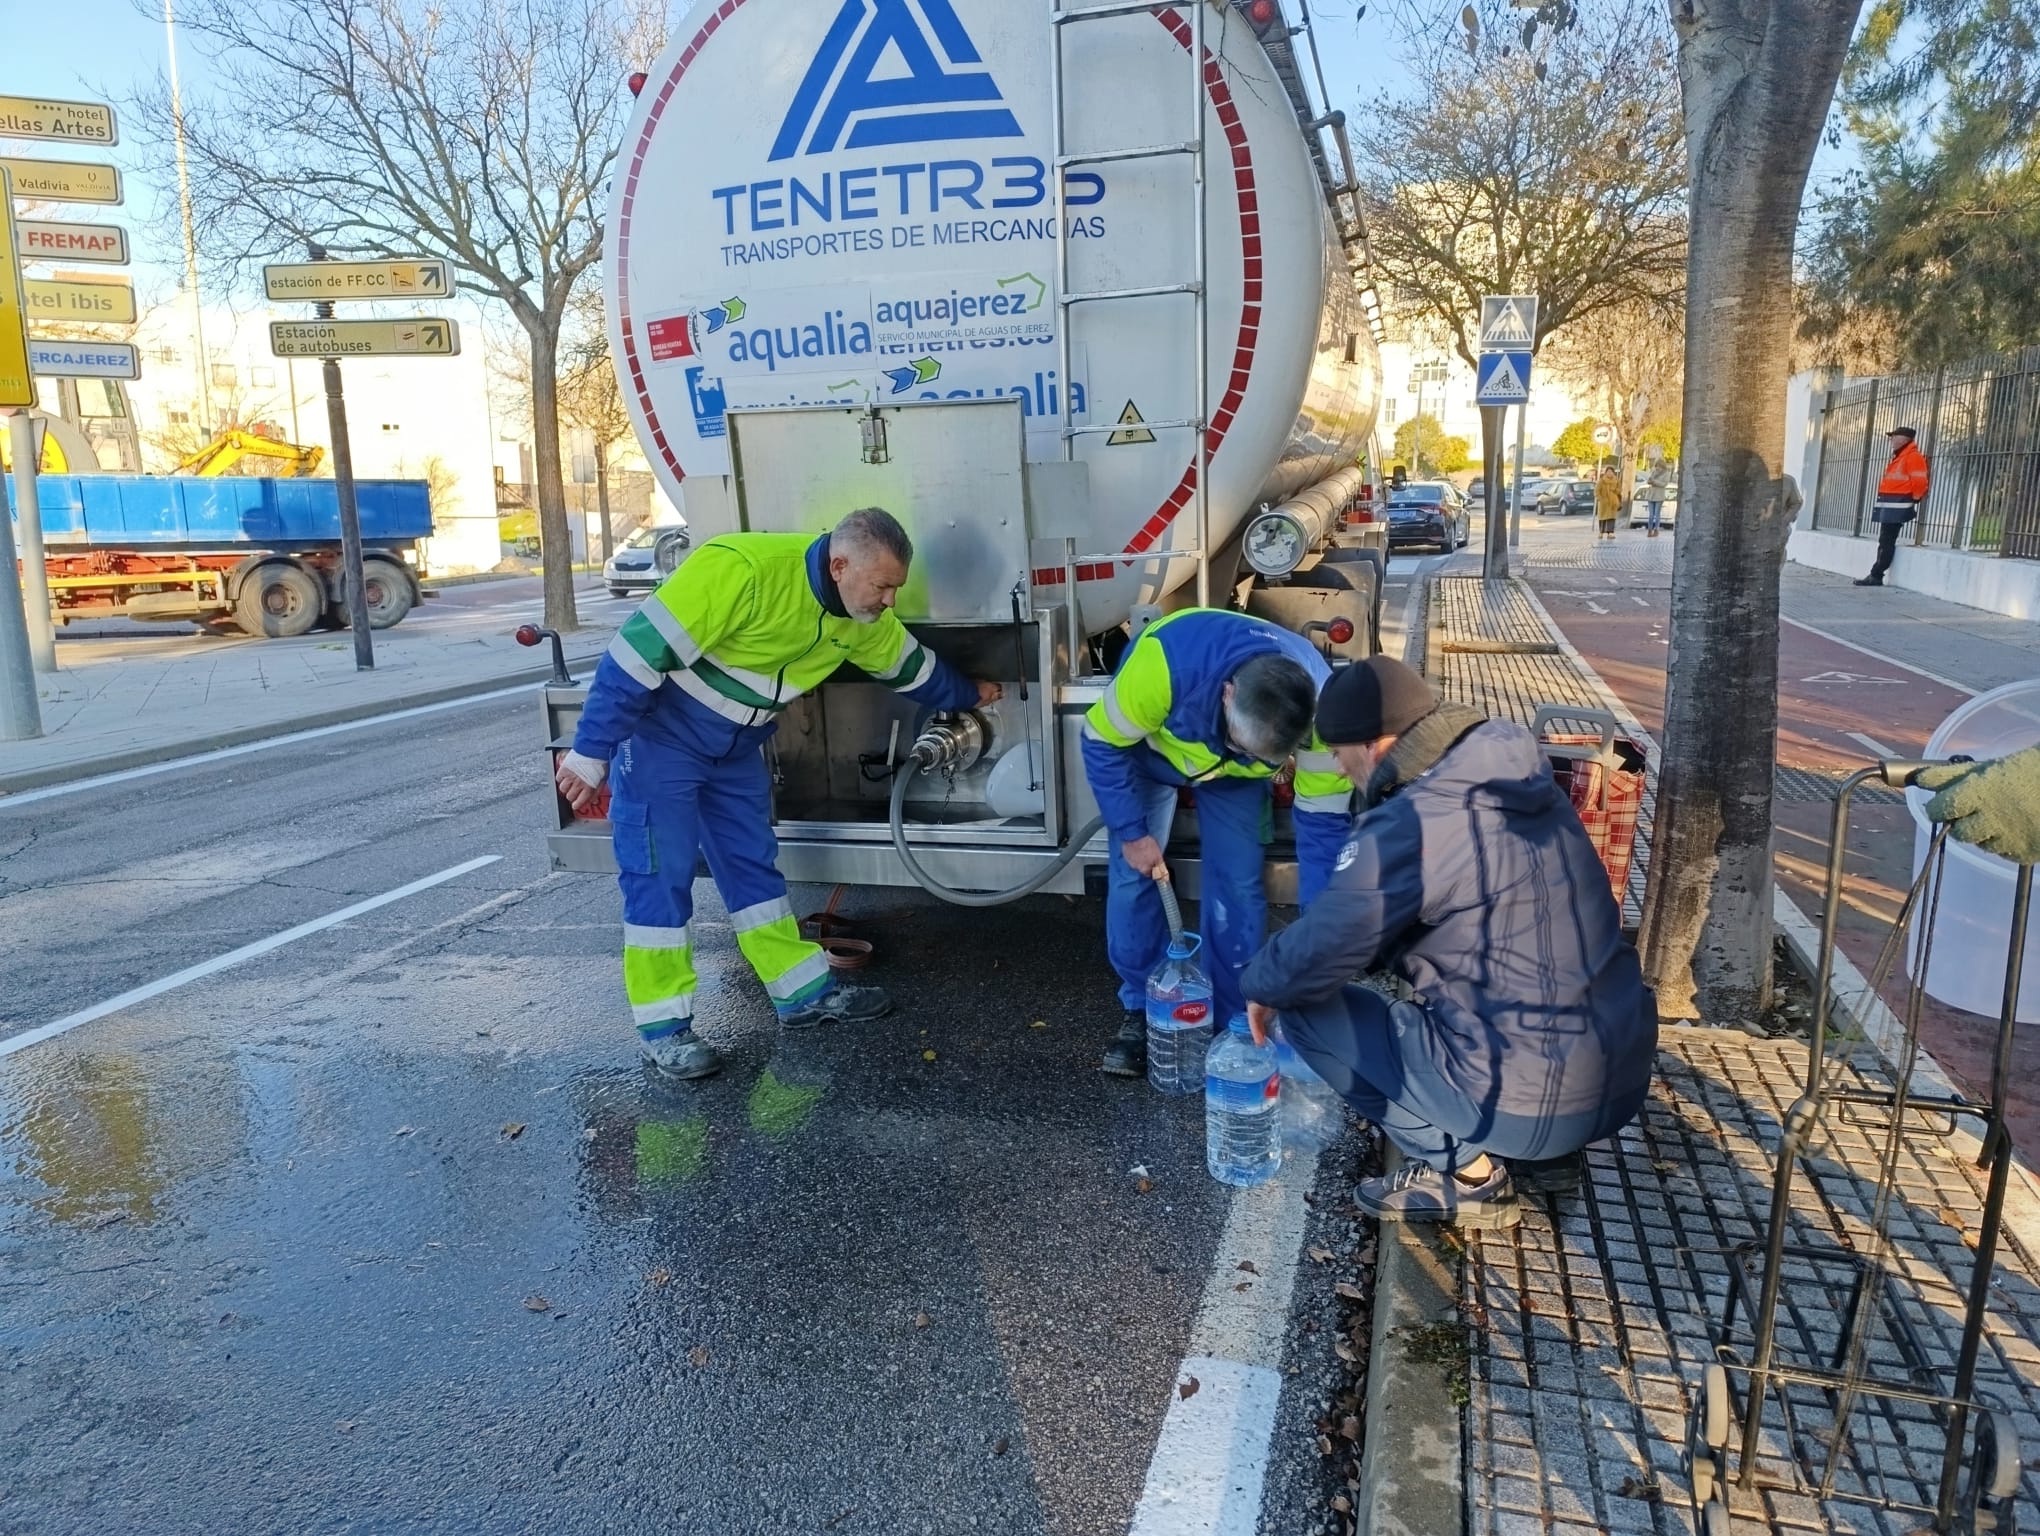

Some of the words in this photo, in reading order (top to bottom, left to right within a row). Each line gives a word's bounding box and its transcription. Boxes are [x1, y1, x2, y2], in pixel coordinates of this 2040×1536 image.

[67, 107, 104, 120] hotel
[0, 115, 43, 131] ellas
[52, 119, 106, 137] Artes
[19, 178, 70, 191] Valdivia
[27, 231, 116, 251] FREMAP
[720, 228, 884, 267] TRANSPORTES
[892, 225, 926, 249] DE
[270, 276, 322, 288] estación
[327, 275, 342, 287] de
[27, 292, 62, 308] tel
[71, 293, 113, 311] ibis
[876, 289, 1027, 328] aquajerez
[276, 325, 336, 338] Estación
[728, 310, 873, 371] aqualia
[878, 332, 915, 342] SERVICIO
[917, 330, 962, 340] MUNICIPAL
[965, 329, 977, 337] DE
[978, 327, 1009, 336] AGUAS
[1011, 325, 1022, 334] DE
[1024, 324, 1049, 333] JEREZ
[278, 341, 294, 353] de
[300, 340, 372, 352] autobuses
[31, 352, 129, 366] ERCAJEREZ
